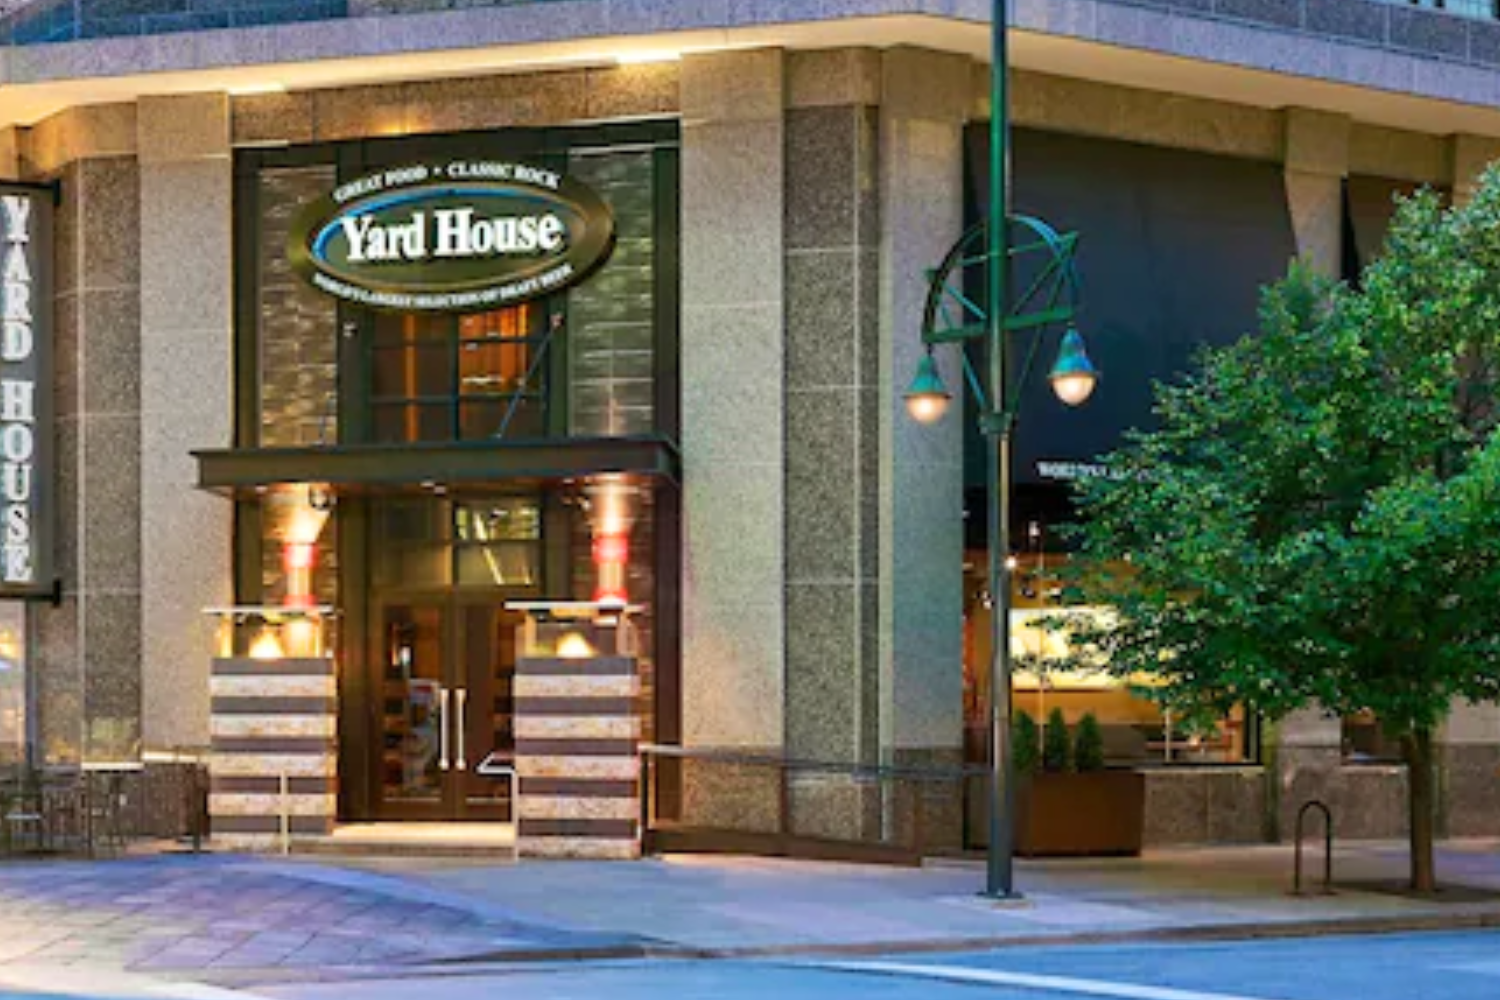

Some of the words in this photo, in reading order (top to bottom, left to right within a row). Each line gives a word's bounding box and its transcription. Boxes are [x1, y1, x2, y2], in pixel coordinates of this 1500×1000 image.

[447, 161, 513, 179] CLASSIC
[513, 164, 561, 189] ROCK
[340, 212, 426, 263] Yard
[433, 206, 565, 258] House
[0, 195, 34, 362] YARD
